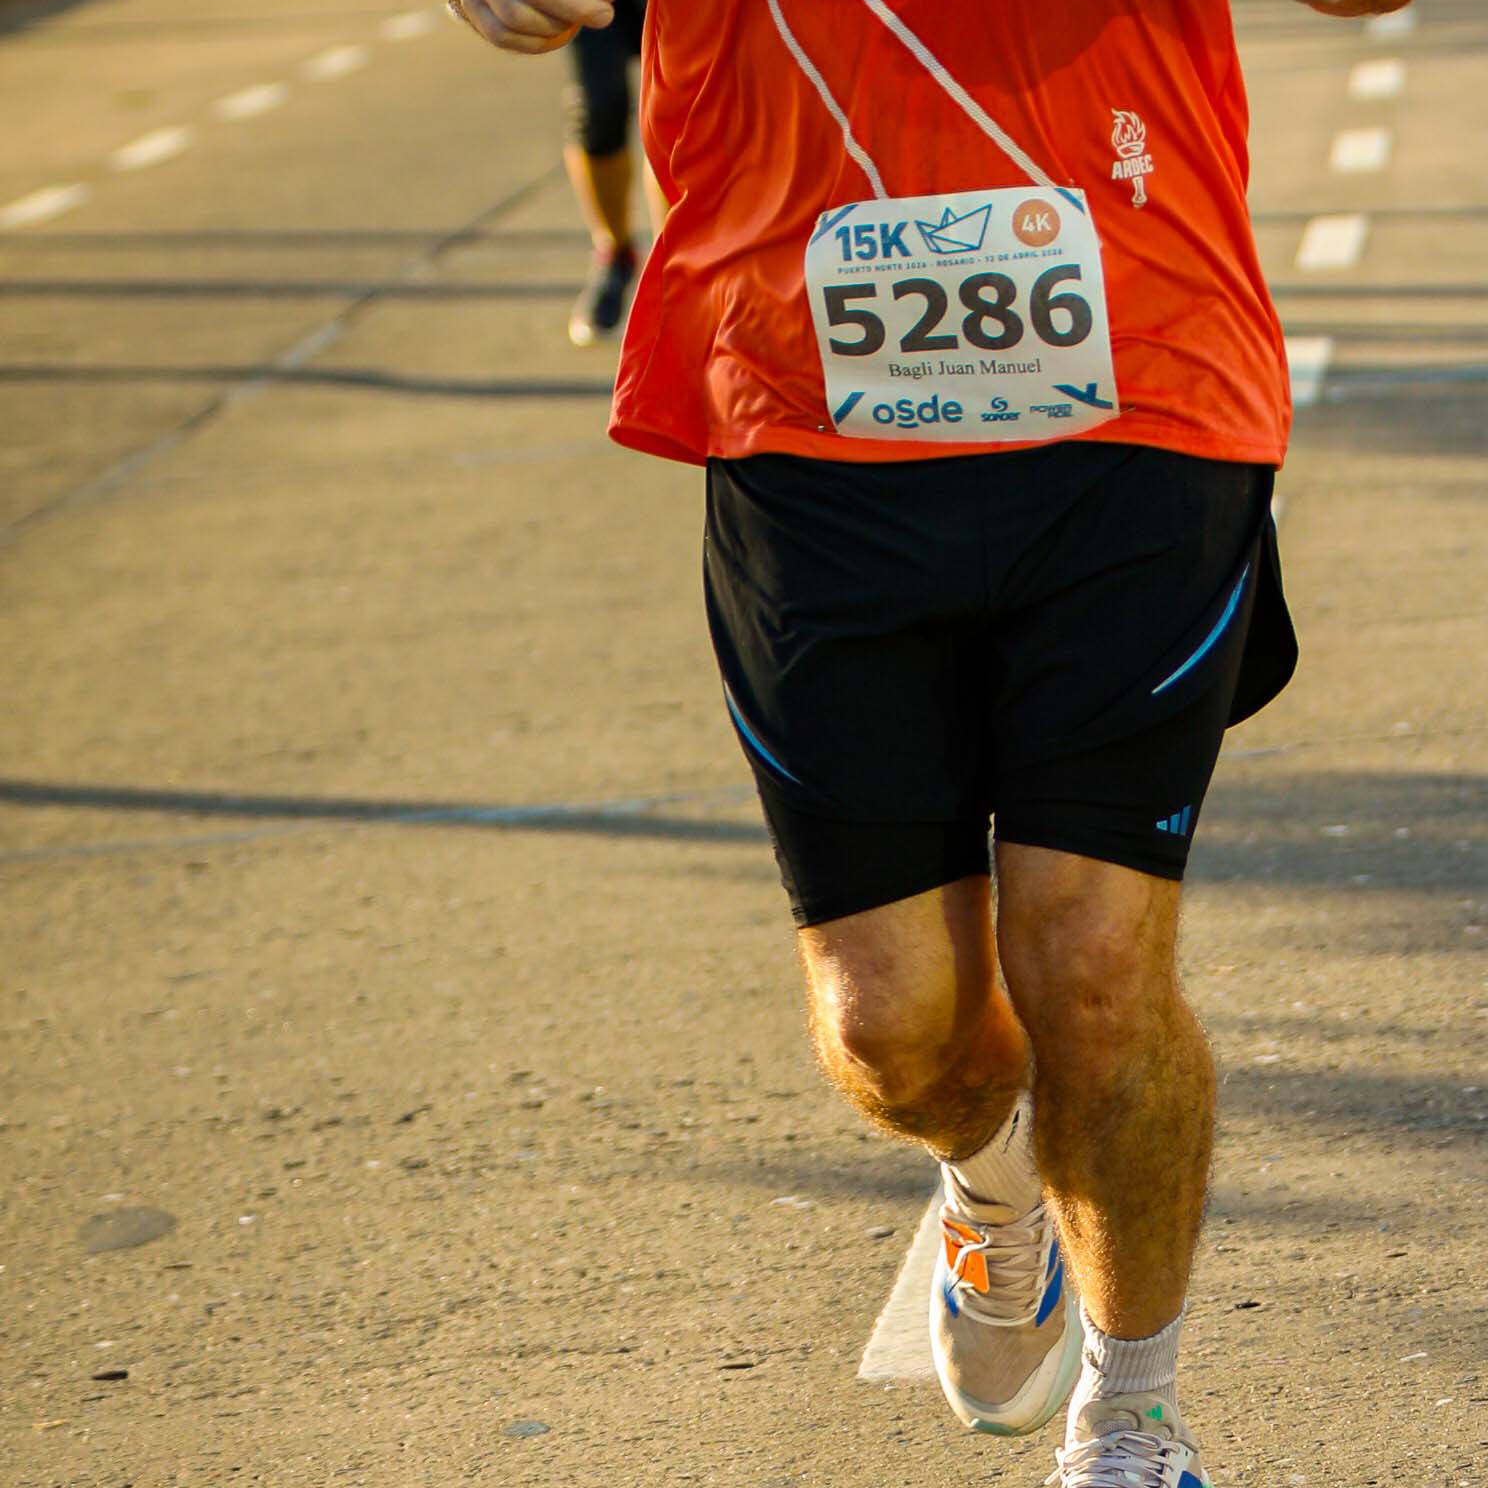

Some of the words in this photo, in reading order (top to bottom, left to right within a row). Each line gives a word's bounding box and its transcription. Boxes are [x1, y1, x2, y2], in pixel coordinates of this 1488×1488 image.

[1111, 154, 1154, 180] ARDEC
[1022, 211, 1052, 232] 4K
[835, 221, 912, 262] 15K
[823, 264, 1092, 356] 5286
[888, 362, 933, 380] Bagli
[938, 361, 975, 377] Juan
[980, 359, 1042, 375] Manuel
[872, 394, 963, 427] osde
